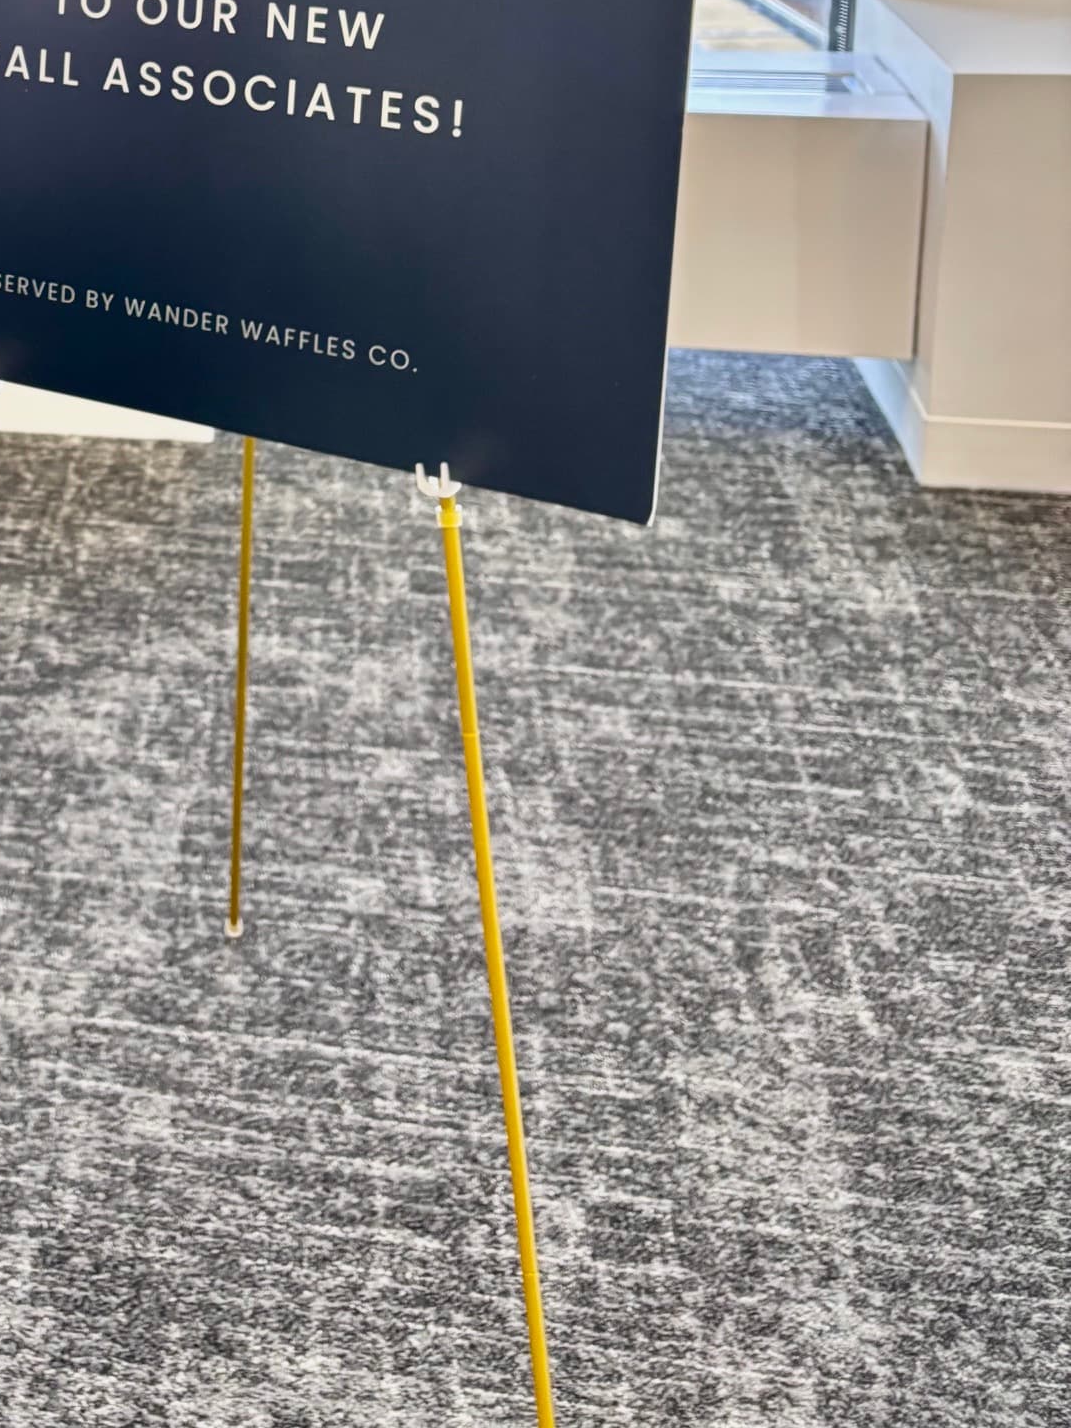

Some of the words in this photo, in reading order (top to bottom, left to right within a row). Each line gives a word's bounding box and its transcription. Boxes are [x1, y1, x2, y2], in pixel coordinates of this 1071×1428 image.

[266, 2, 385, 50] NEW
[102, 57, 463, 138] ASSOCIATES!
[85, 289, 114, 312] BY
[124, 296, 229, 335] WANDER
[240, 319, 356, 360] WAFFLES
[368, 345, 418, 373] CO.
